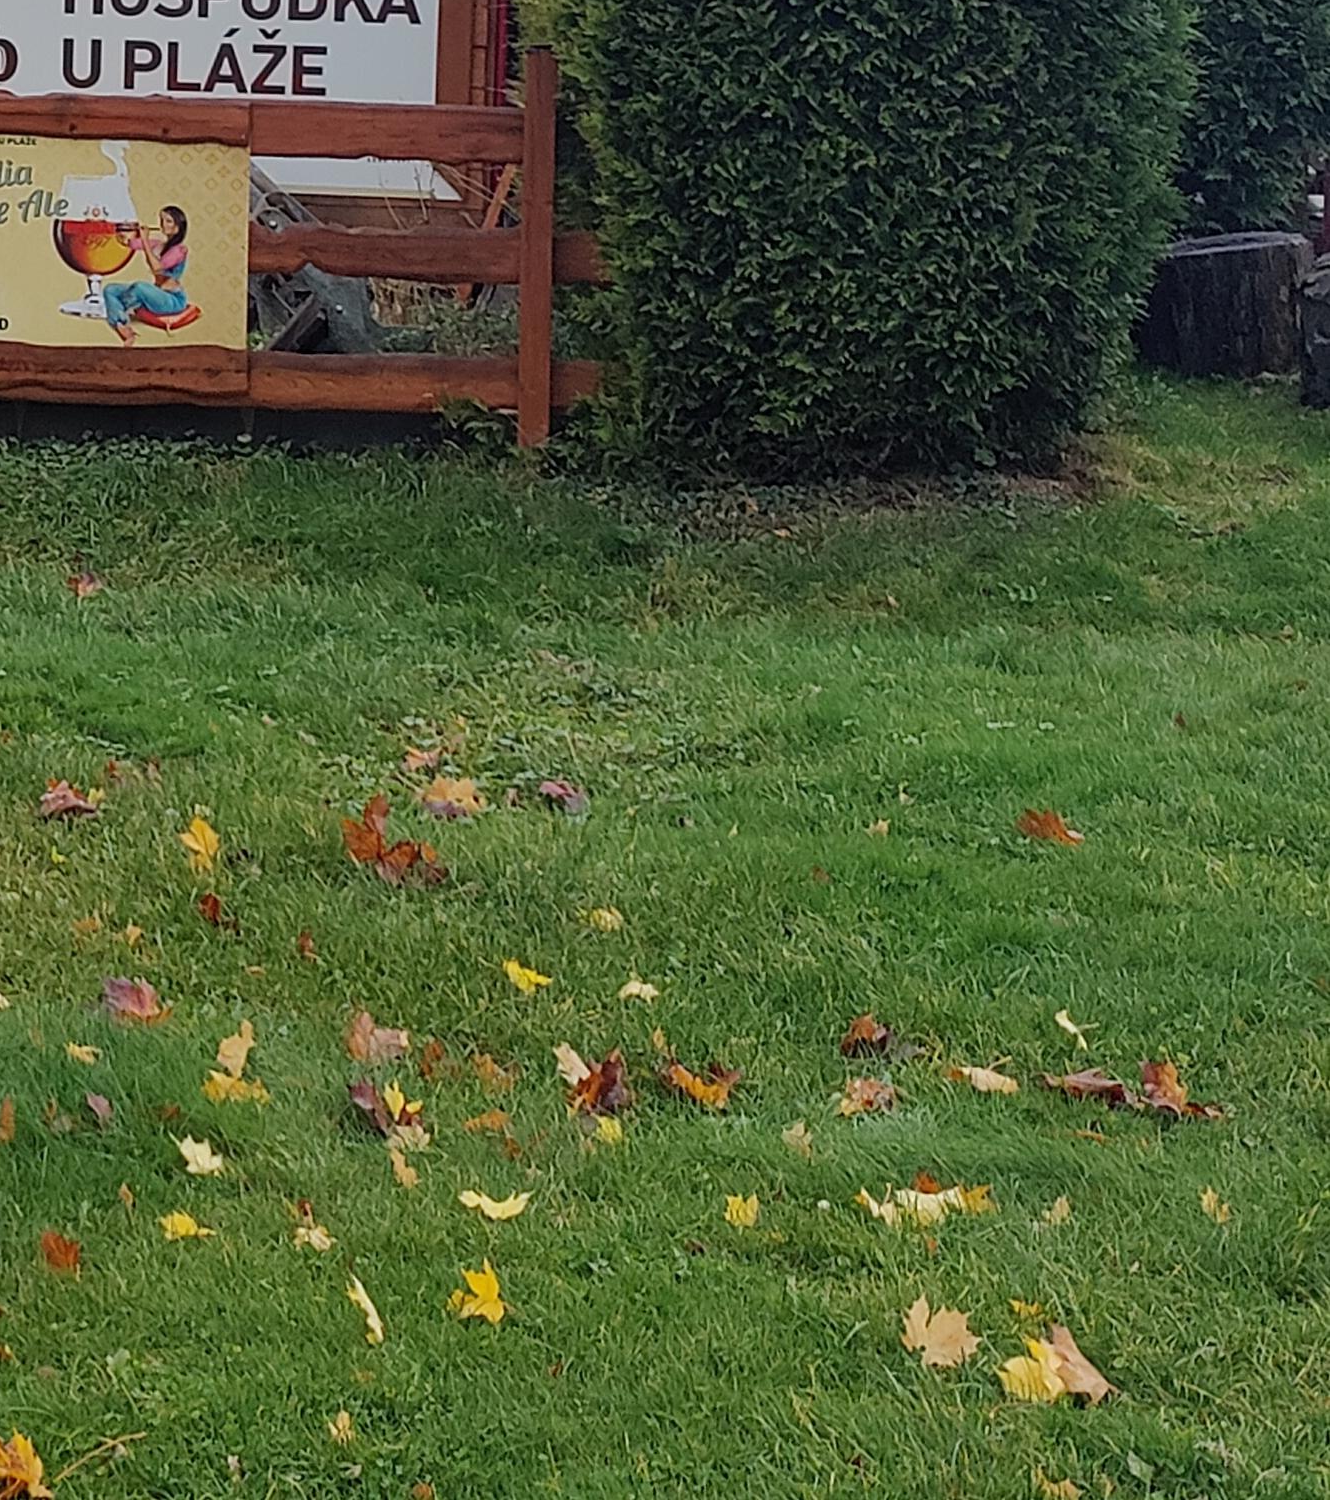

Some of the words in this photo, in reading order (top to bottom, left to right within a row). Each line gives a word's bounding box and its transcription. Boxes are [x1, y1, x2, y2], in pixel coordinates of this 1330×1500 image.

[61, 37, 104, 89] U
[125, 28, 329, 98] PLÁŽE
[17, 189, 69, 223] Ale
